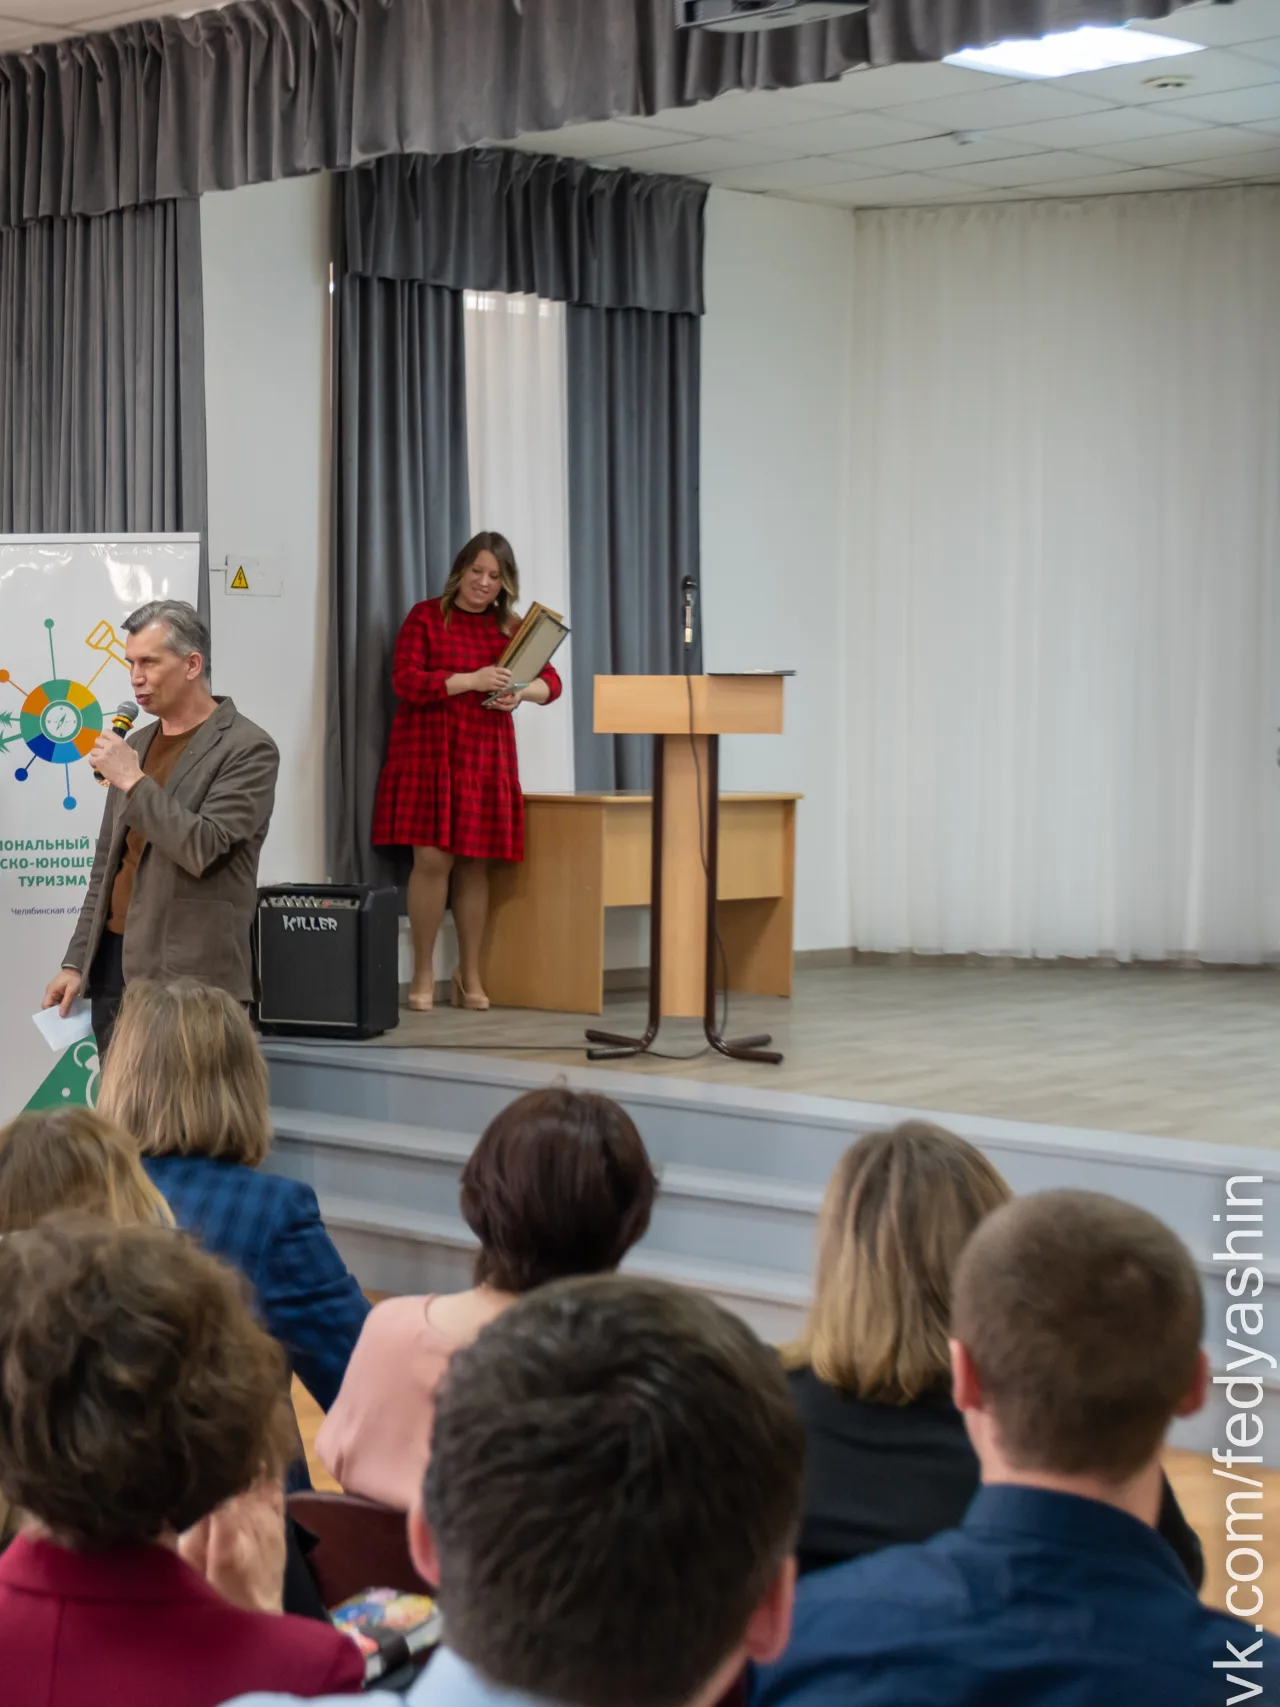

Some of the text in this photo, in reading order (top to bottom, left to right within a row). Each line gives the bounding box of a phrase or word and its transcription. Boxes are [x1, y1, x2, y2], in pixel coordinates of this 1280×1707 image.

[0, 857, 95, 869] СКО-ЮНОШЕ
[18, 875, 87, 887] ТУРИЗМА
[11, 905, 81, 915] Челябинская обл
[282, 915, 338, 931] KILLER
